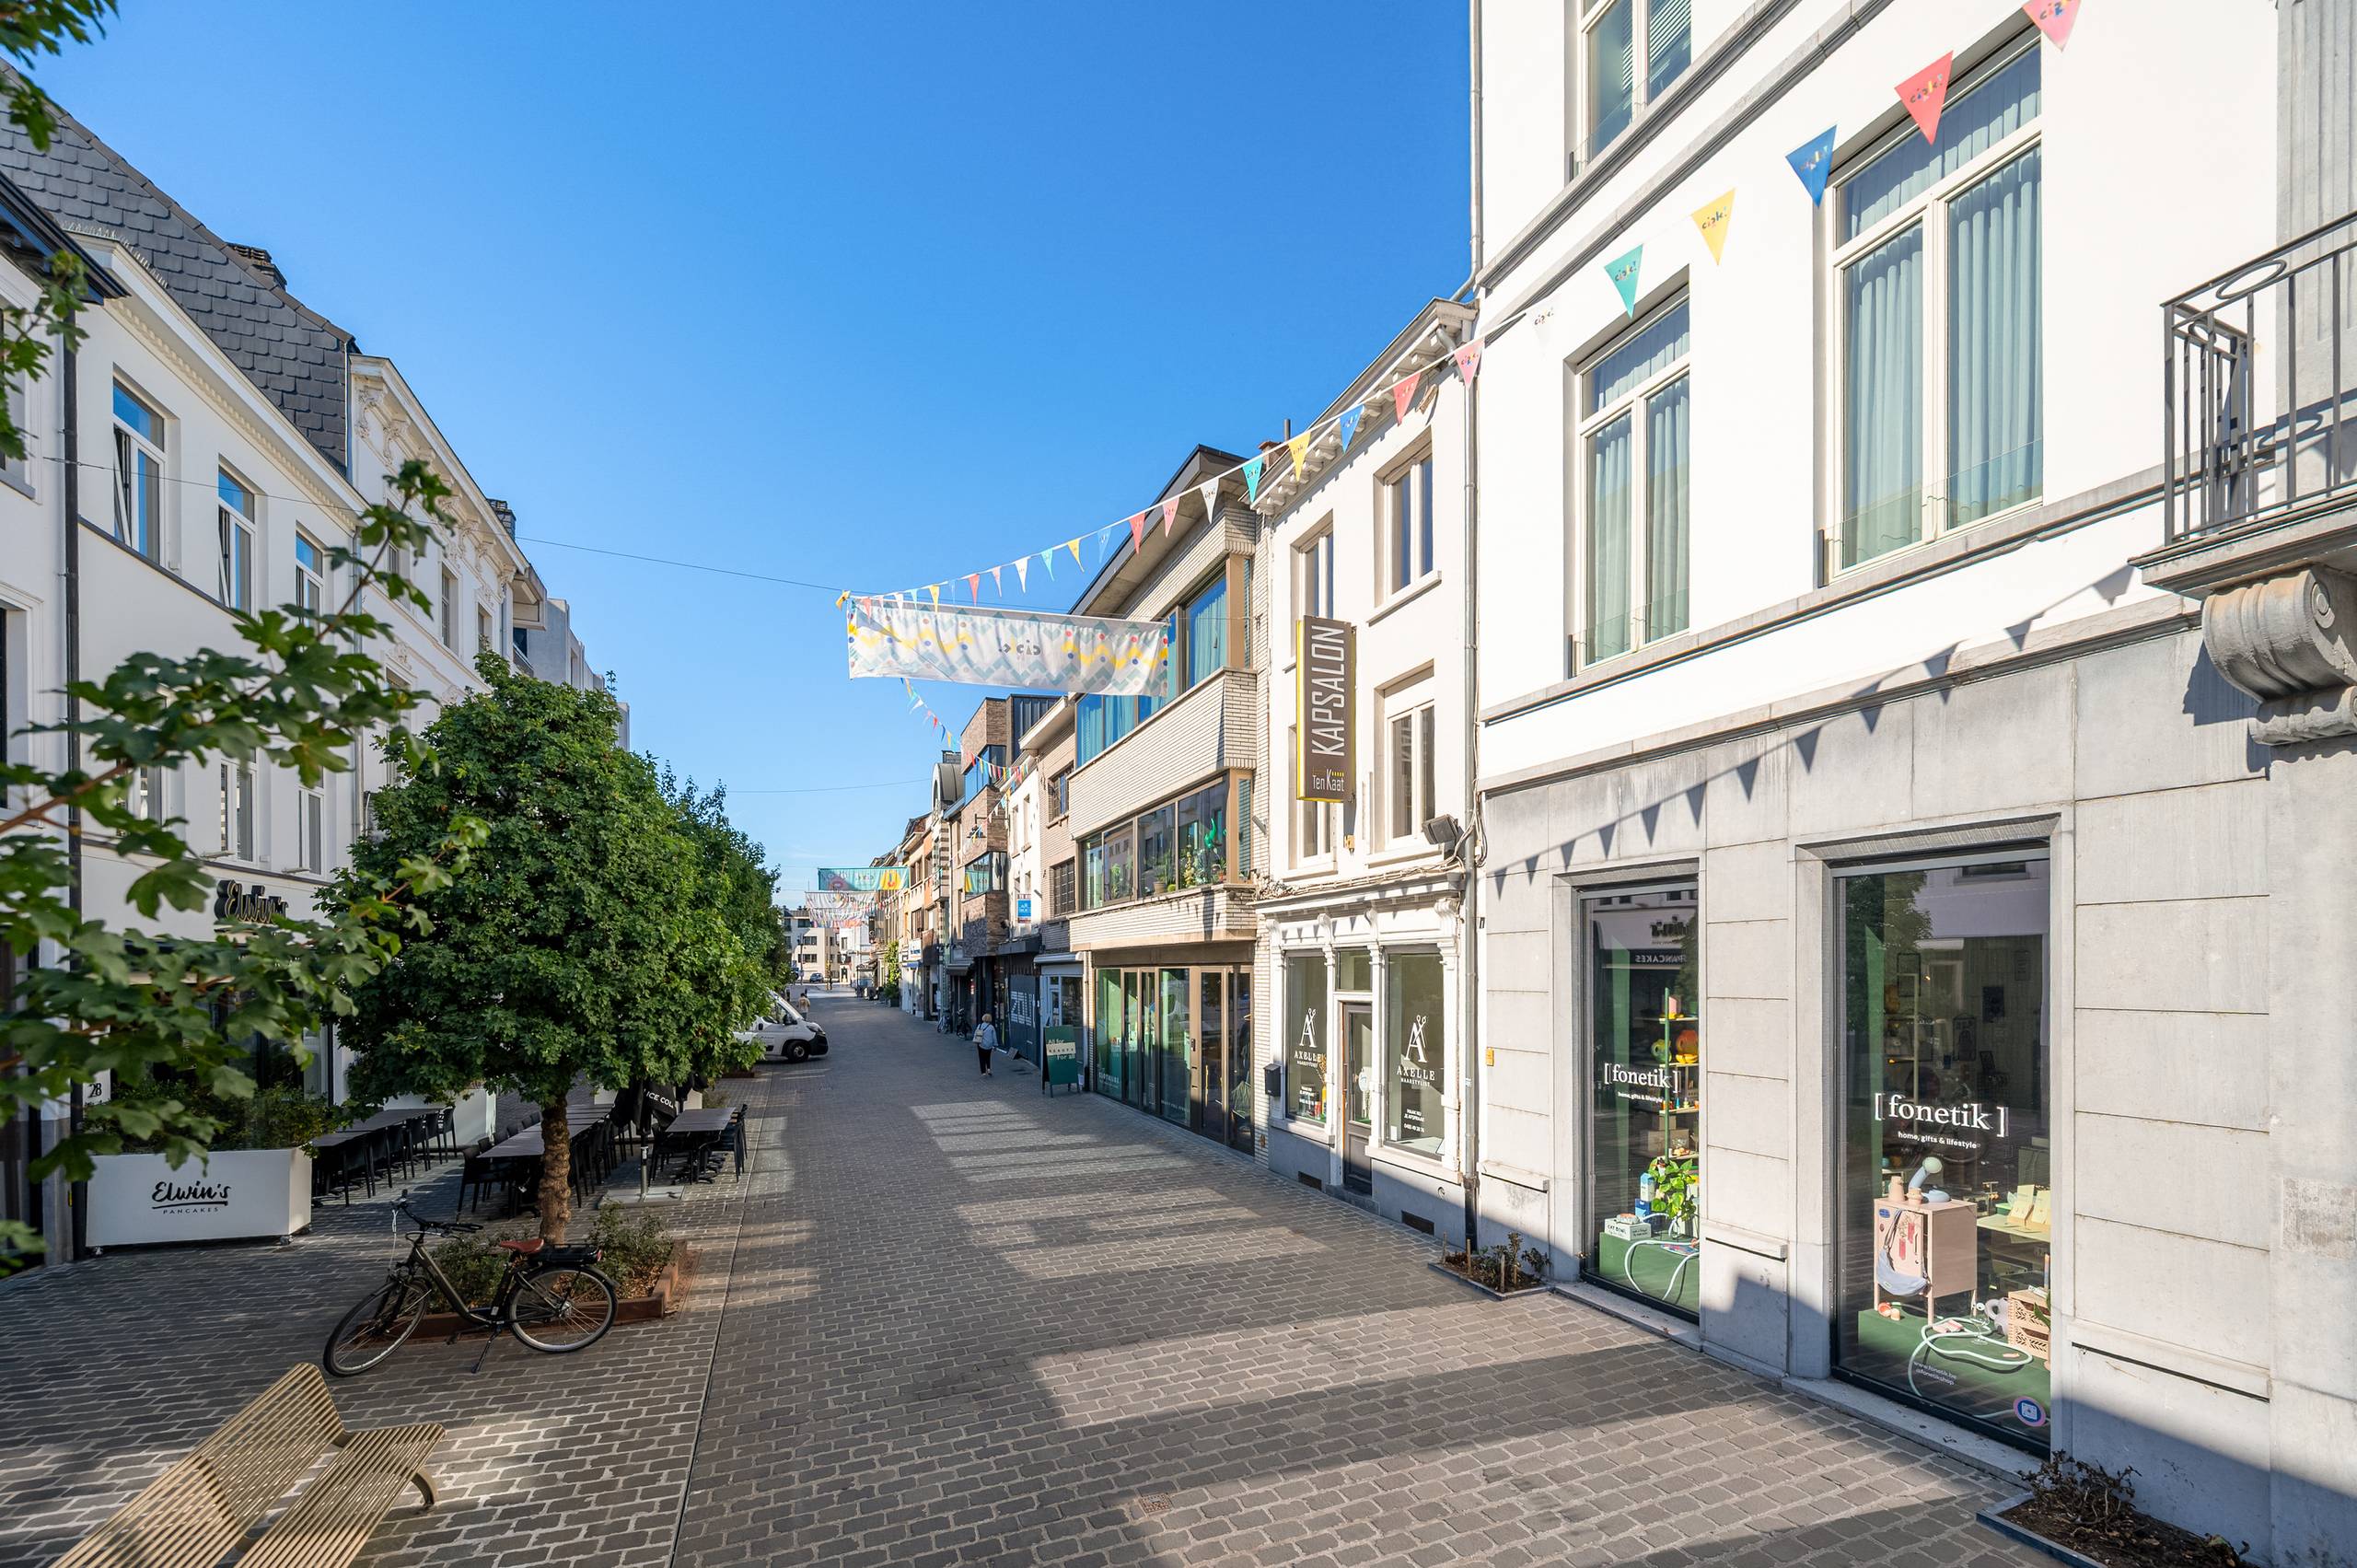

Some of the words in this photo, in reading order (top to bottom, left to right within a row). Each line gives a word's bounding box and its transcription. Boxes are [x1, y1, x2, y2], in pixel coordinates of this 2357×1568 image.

[1311, 625, 1345, 757] KAPSALON
[1312, 774, 1326, 790] Ten
[1326, 768, 1345, 793] Kaat
[1294, 1050, 1322, 1063] AXELLE
[1397, 1065, 1436, 1081] AXELLE
[87, 1082, 103, 1098] 28
[1400, 1078, 1431, 1086] HAARSTYLIST
[646, 1091, 659, 1101] ICE
[1898, 1131, 1920, 1142] home,
[1921, 1134, 1938, 1144] gifts
[1946, 1137, 1978, 1150] lifestyle
[151, 1179, 232, 1203] Elwin's
